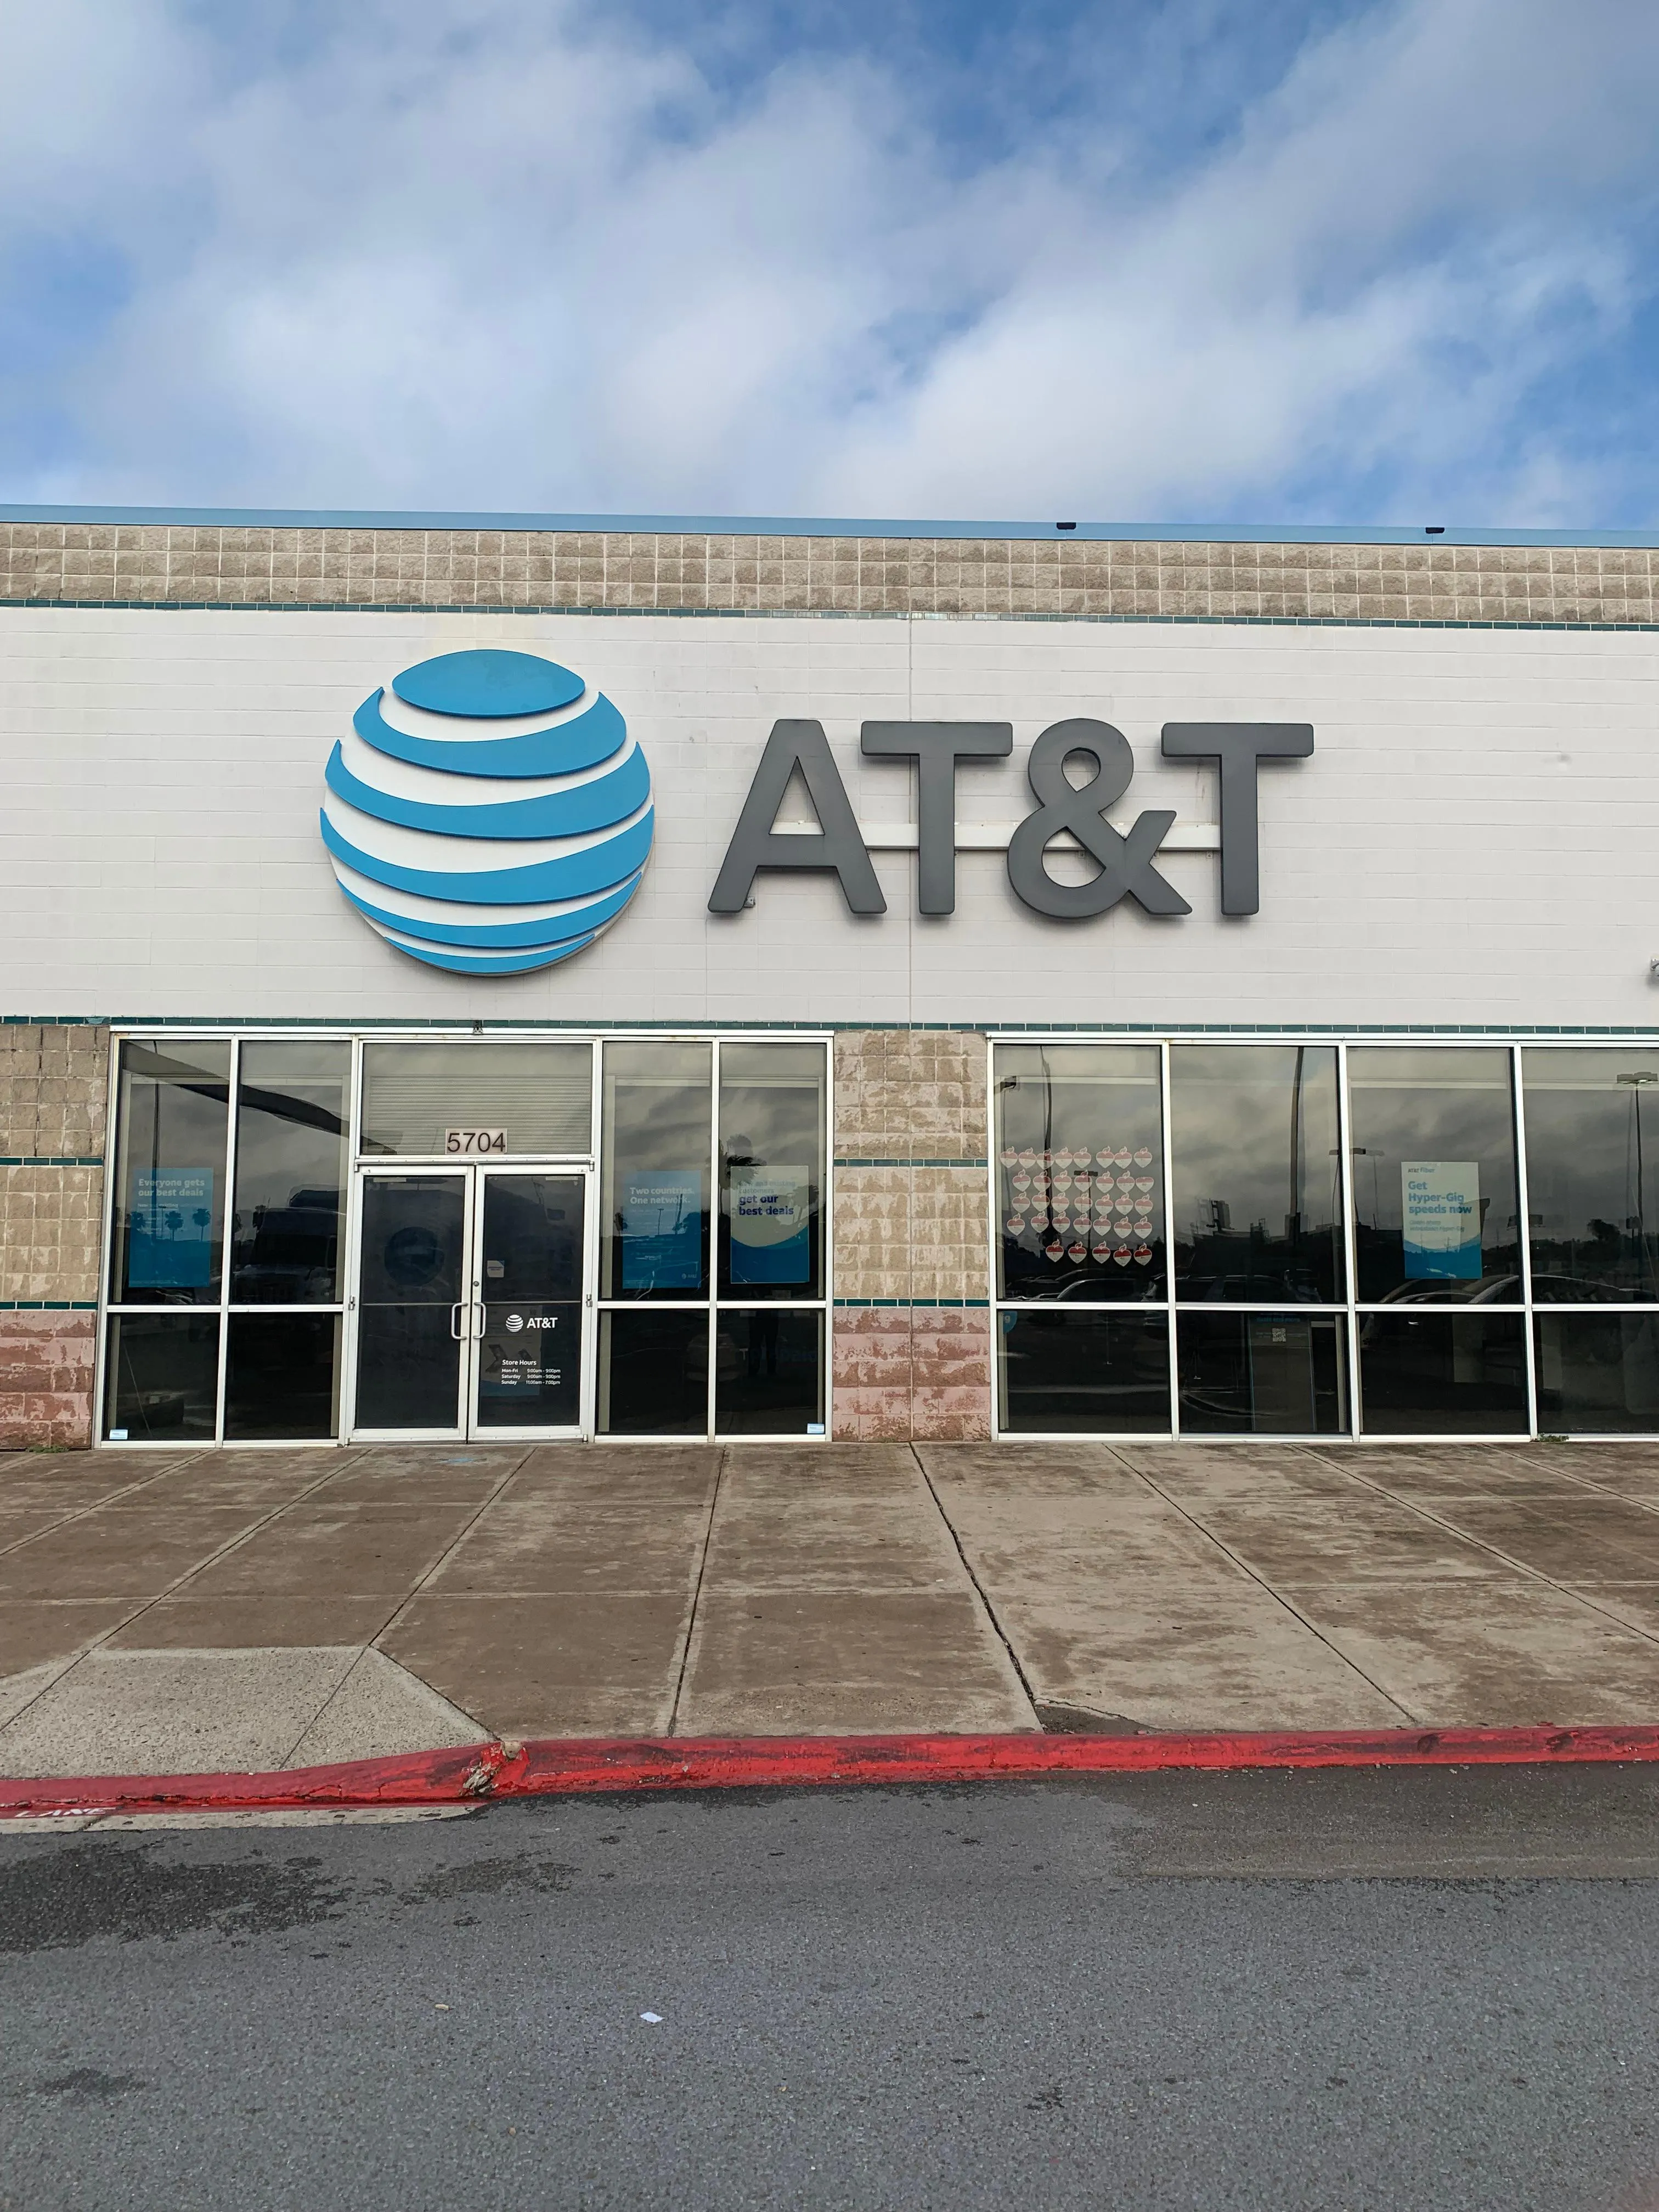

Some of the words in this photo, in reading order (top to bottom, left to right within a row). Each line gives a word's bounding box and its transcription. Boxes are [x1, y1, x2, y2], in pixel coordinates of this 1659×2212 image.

[708, 718, 1314, 919] AT&T
[447, 1132, 506, 1152] 5704
[138, 1178, 182, 1188] Everyone
[184, 1179, 205, 1188] gets
[1408, 1181, 1428, 1190] Get
[179, 1188, 204, 1197] deals
[629, 1187, 649, 1195] Two
[739, 1195, 758, 1205] get
[1408, 1192, 1464, 1205] Hyper-Gig
[739, 1206, 763, 1215] best
[765, 1205, 794, 1215] deals
[1409, 1204, 1447, 1216] speeds
[527, 1317, 558, 1329] AT&T
[14, 1807, 116, 1818] LANE
